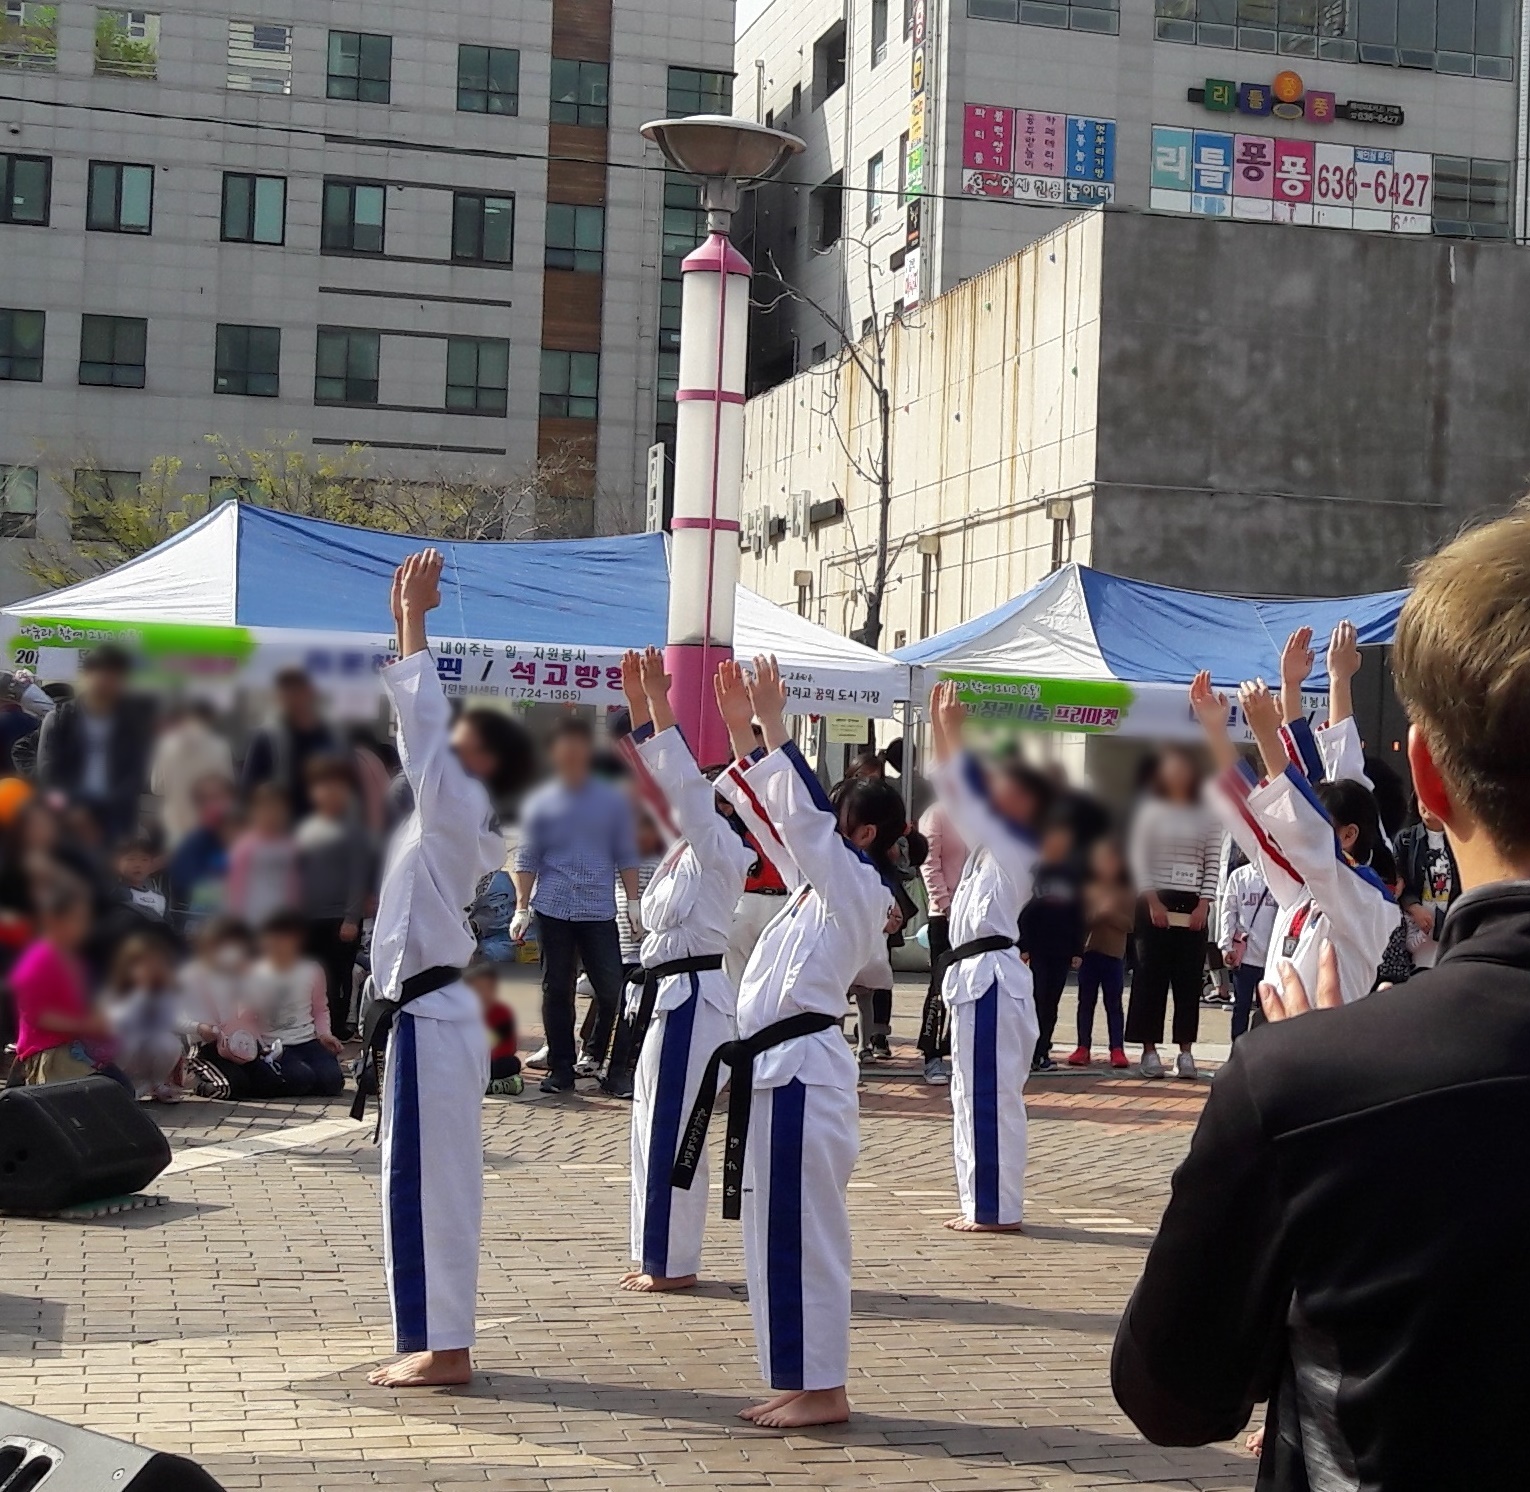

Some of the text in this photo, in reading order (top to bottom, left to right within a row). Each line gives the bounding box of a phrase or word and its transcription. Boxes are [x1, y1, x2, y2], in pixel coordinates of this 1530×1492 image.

[1034, 179, 1062, 200] 전용
[1067, 182, 1112, 202] 놀이터
[1317, 163, 1430, 208] 636-6427
[20, 626, 52, 642] 나눔과
[57, 626, 84, 643] 참여
[533, 647, 587, 662] 자원봉사
[814, 688, 835, 701] 꿈의
[838, 689, 857, 703] 도시
[860, 690, 880, 704] 기장
[1017, 702, 1050, 722] 나눔
[1054, 705, 1119, 727] 프리마켓
